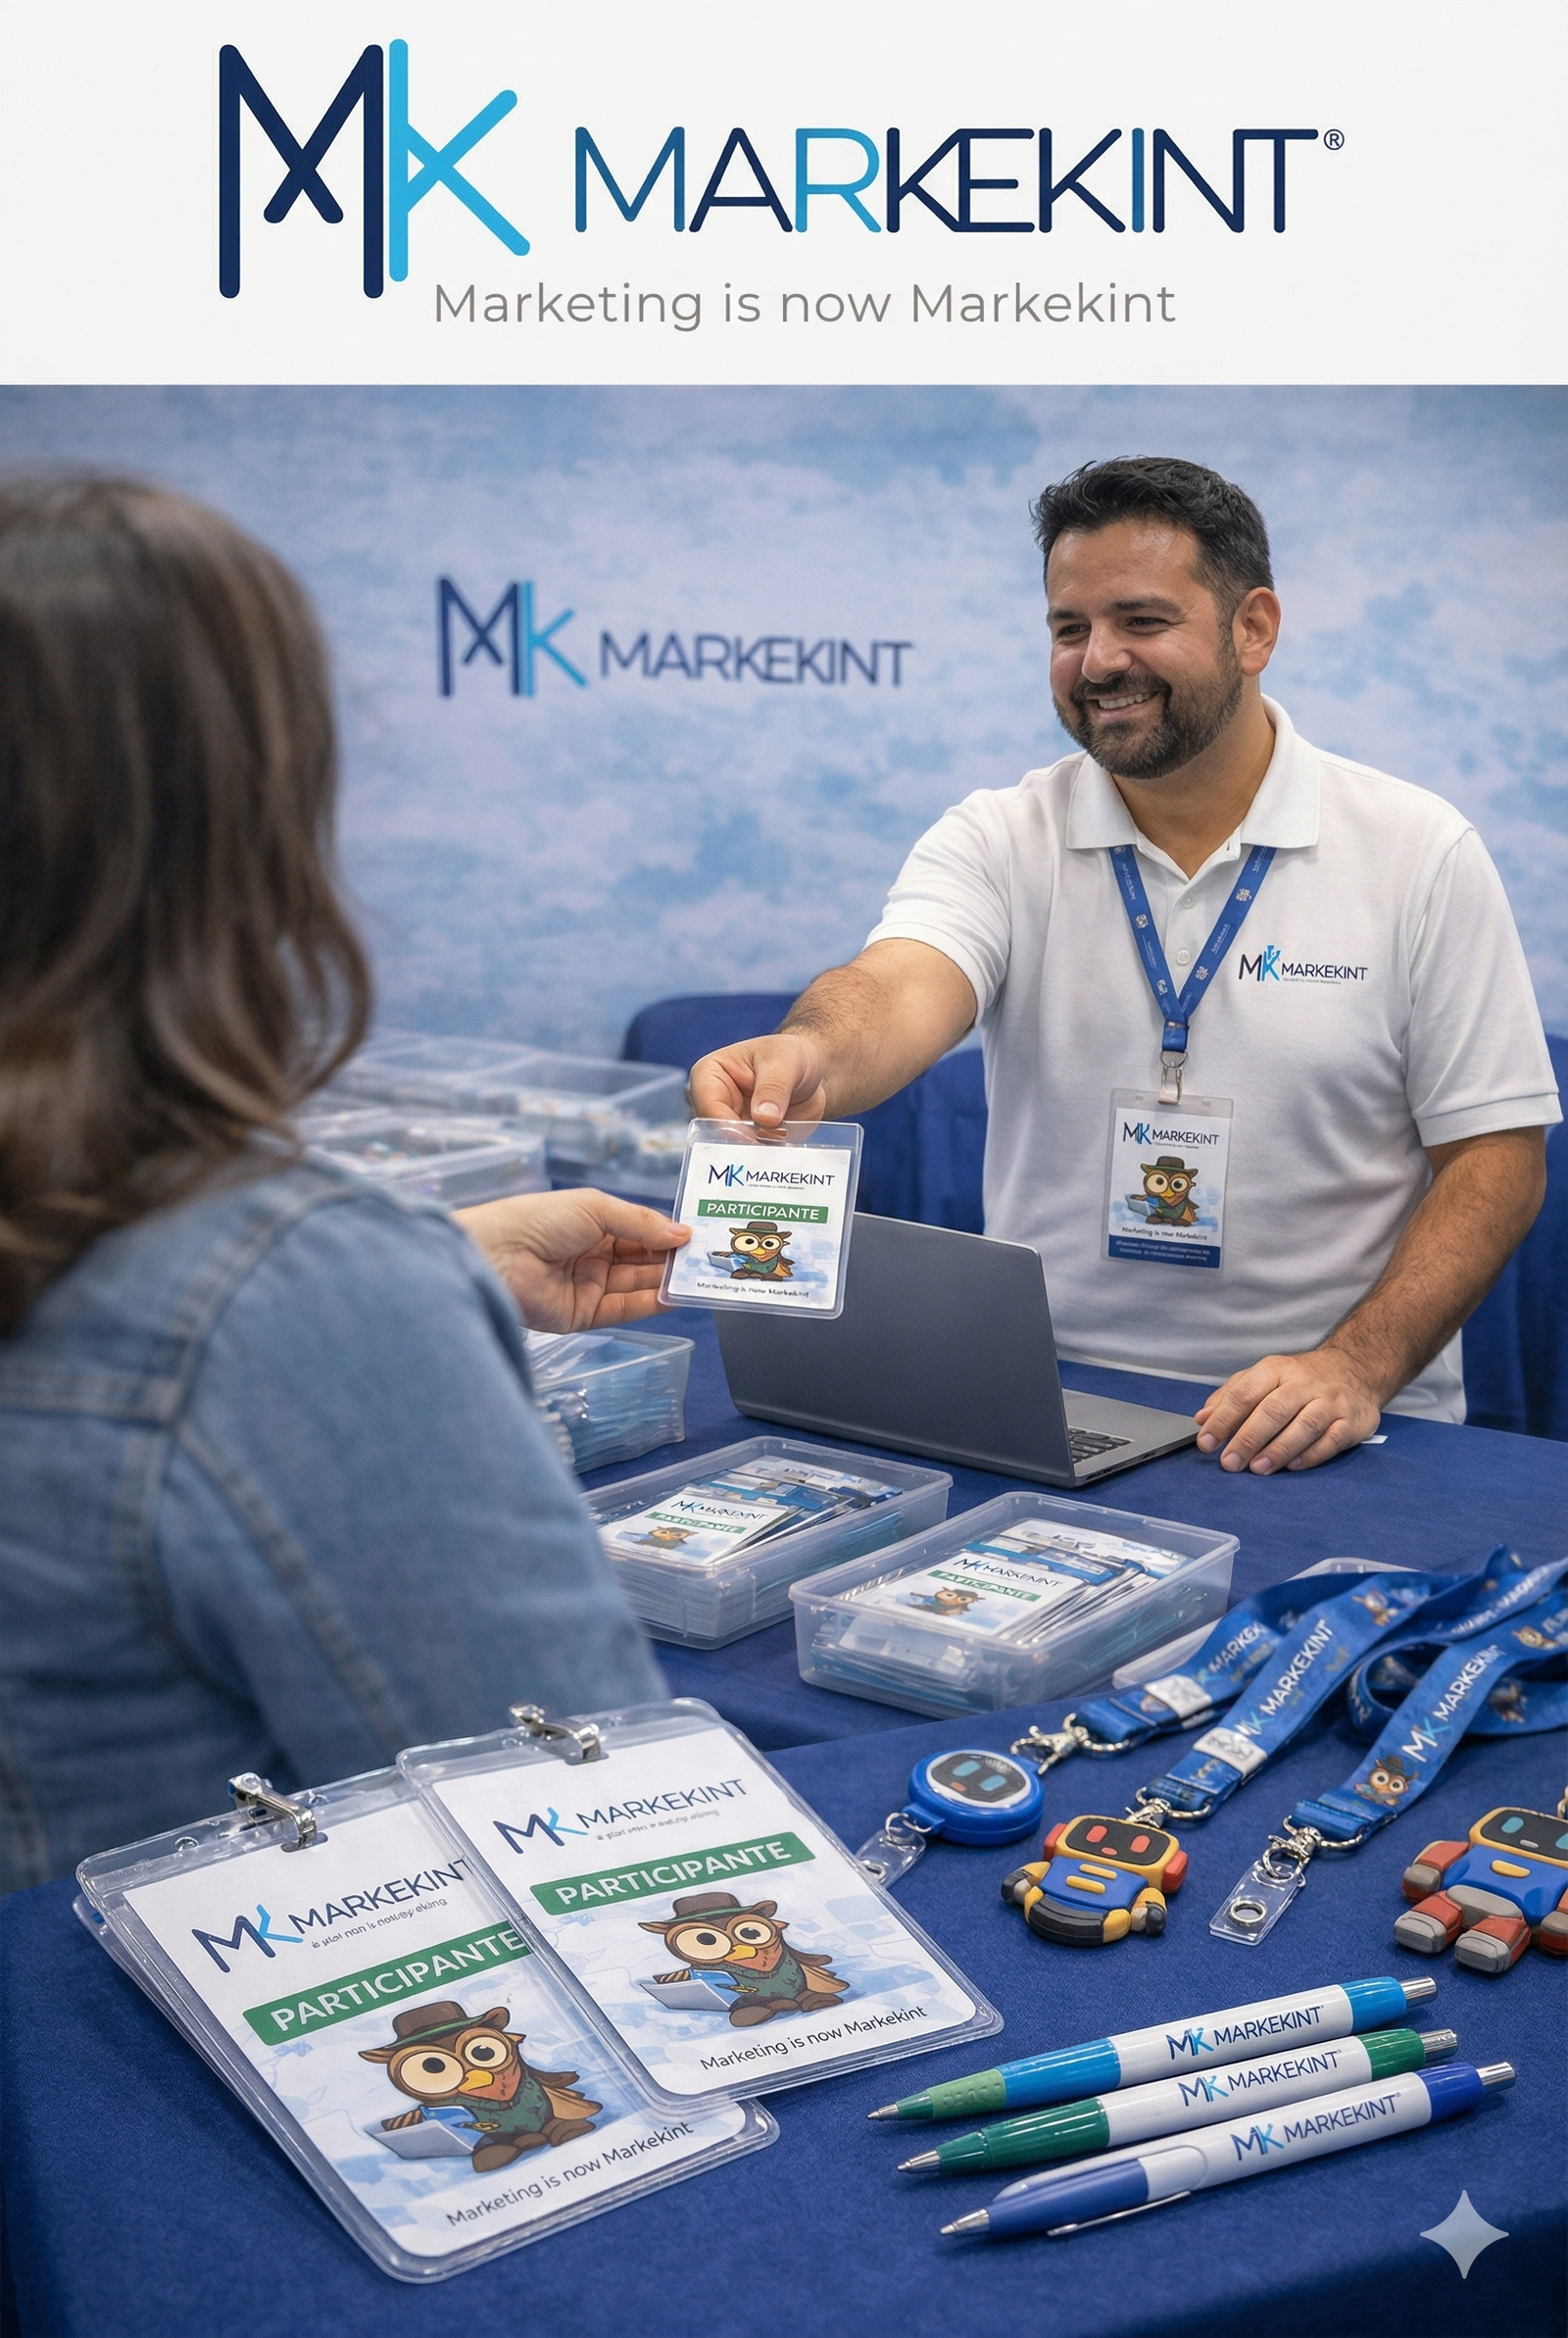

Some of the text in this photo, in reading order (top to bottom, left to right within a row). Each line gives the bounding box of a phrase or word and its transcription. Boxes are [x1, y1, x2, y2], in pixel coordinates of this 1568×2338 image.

[599, 629, 913, 688] MARKEKINT
[1281, 962, 1368, 980] MARKEKINT
[1152, 1128, 1220, 1146] MARKEKINT
[708, 1164, 835, 1187] MK MARKEKINT
[707, 1202, 819, 1220] PARTICIPANTE
[1259, 1617, 1335, 1716] MARKEKINT
[575, 1778, 747, 1829] MARKEKINT
[555, 1841, 792, 1906] PARTICIPANTE
[270, 1928, 526, 2032] PARTICIPANTE
[700, 2006, 928, 2070] Marketing is now Markekint
[1214, 2006, 1321, 2046] MARKEKINT
[1227, 2051, 1339, 2091] MARKEKINT
[446, 2121, 695, 2226] Marketing is now Markekint
